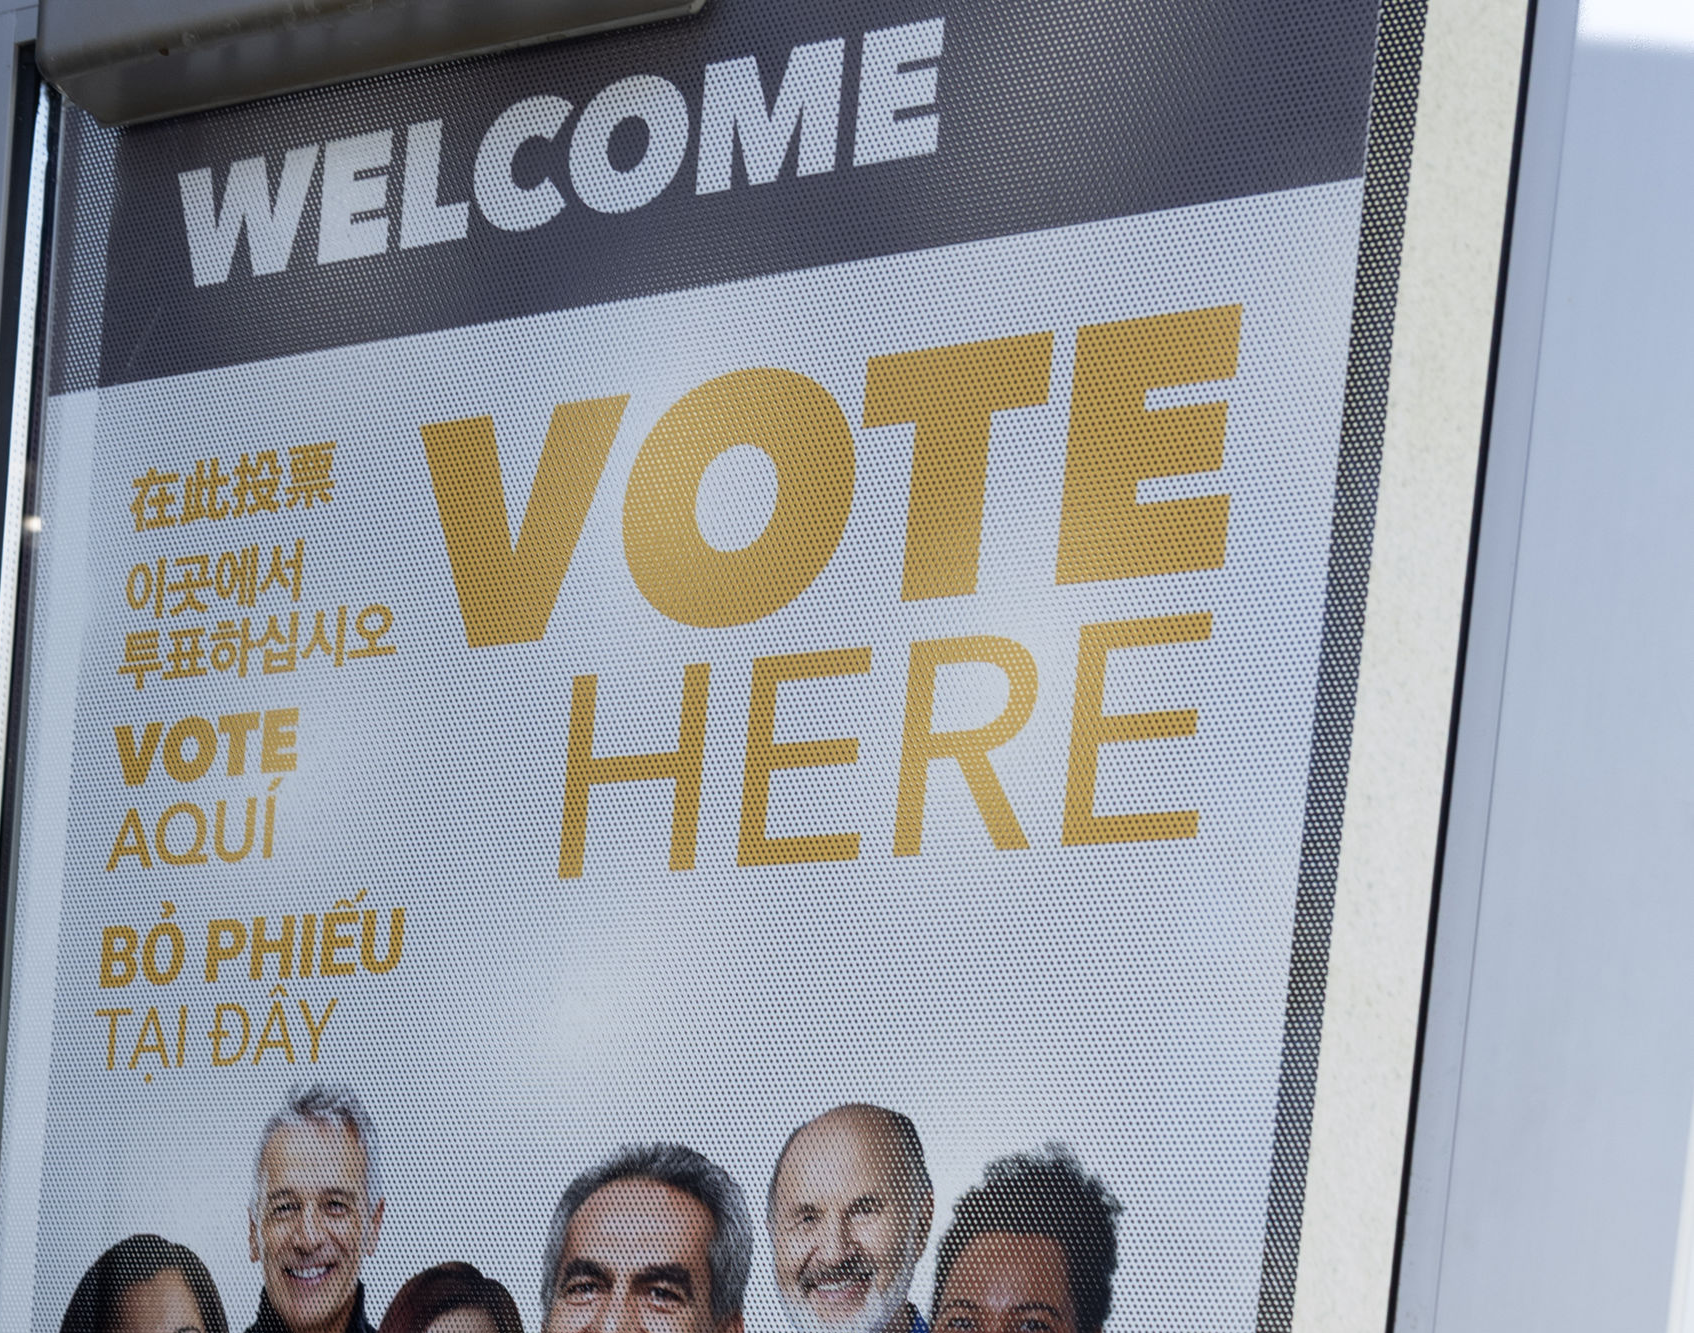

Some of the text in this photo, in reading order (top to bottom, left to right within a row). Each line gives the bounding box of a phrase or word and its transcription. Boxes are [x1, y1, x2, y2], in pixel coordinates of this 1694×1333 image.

[177, 15, 945, 289] WELCOME
[129, 440, 337, 532] 在此投票
[420, 302, 1244, 651] VOTE
[124, 537, 305, 619] 이곳에서
[116, 603, 397, 690] 투표하십시오
[113, 706, 300, 788] VOTE
[556, 610, 1214, 880] HERE
[104, 776, 284, 873] AQUÍ
[99, 888, 406, 989] BỎ PHIẾU
[94, 983, 339, 1084] TẠI ĐÂY
